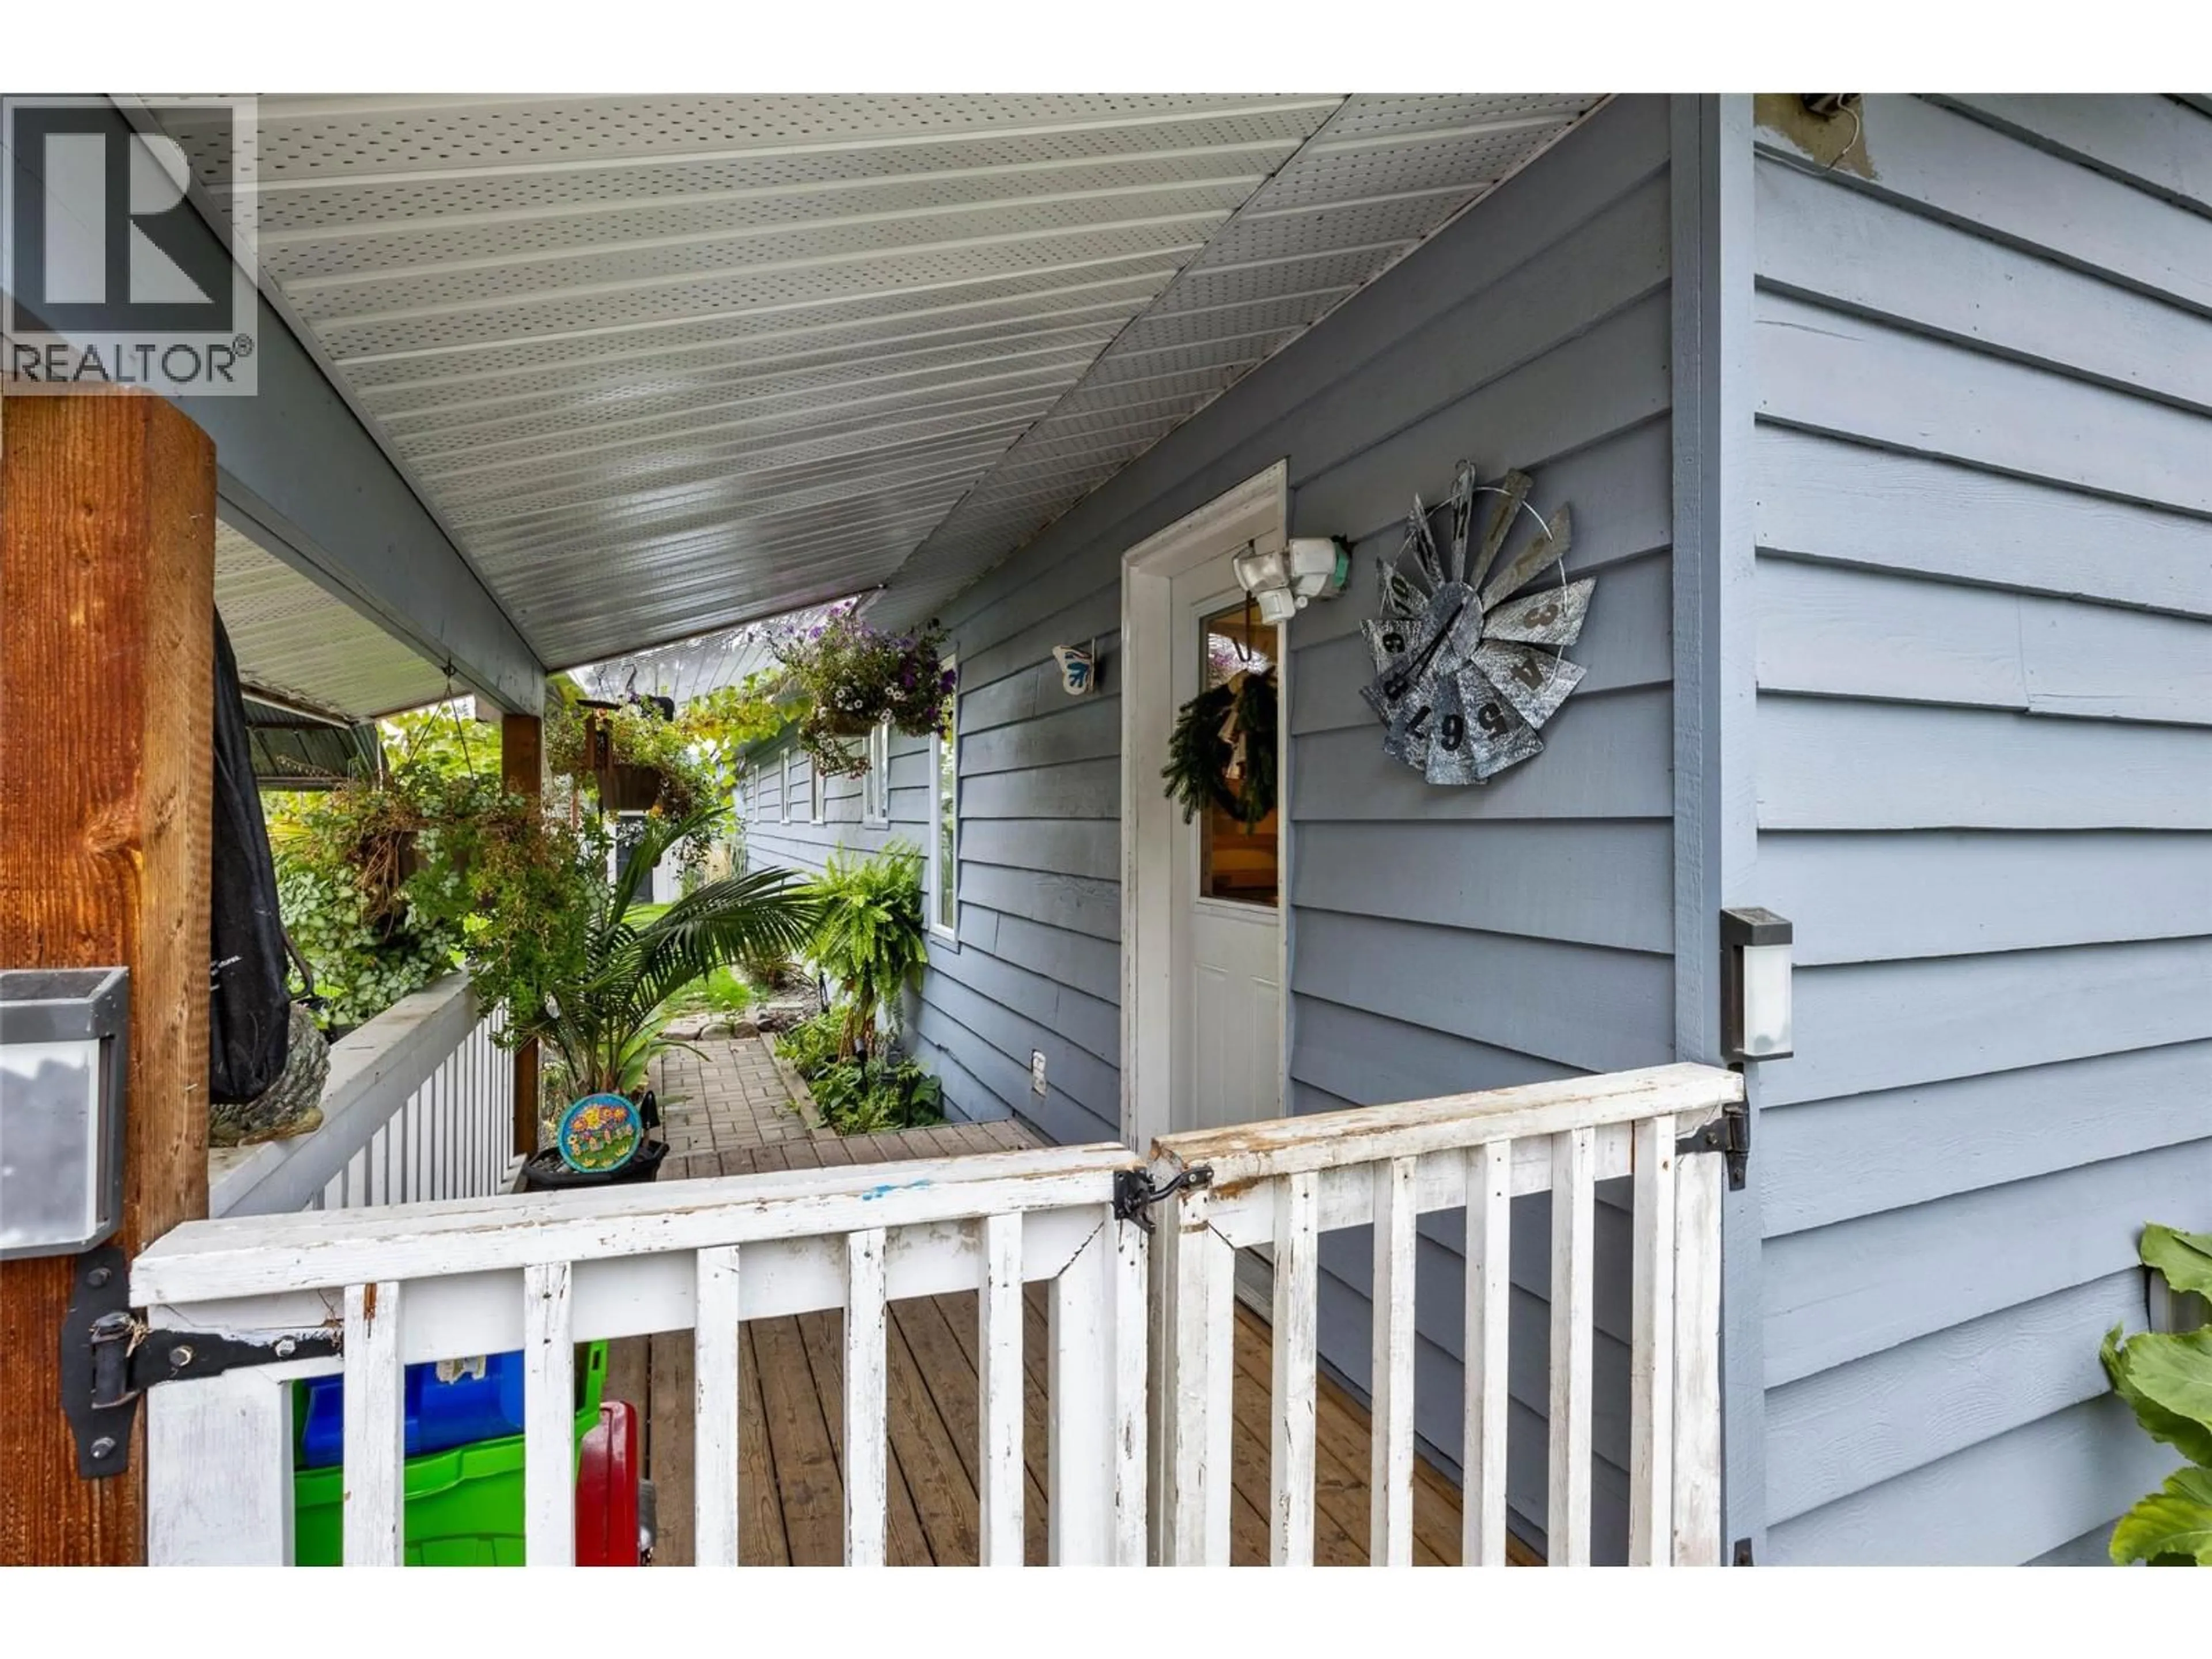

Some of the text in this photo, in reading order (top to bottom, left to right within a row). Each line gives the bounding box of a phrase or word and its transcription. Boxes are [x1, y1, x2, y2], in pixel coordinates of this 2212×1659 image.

[1524, 604, 1558, 628] 3
[1510, 658, 1545, 691] 4
[1405, 705, 1431, 739] 7
[1478, 702, 1509, 741] 5
